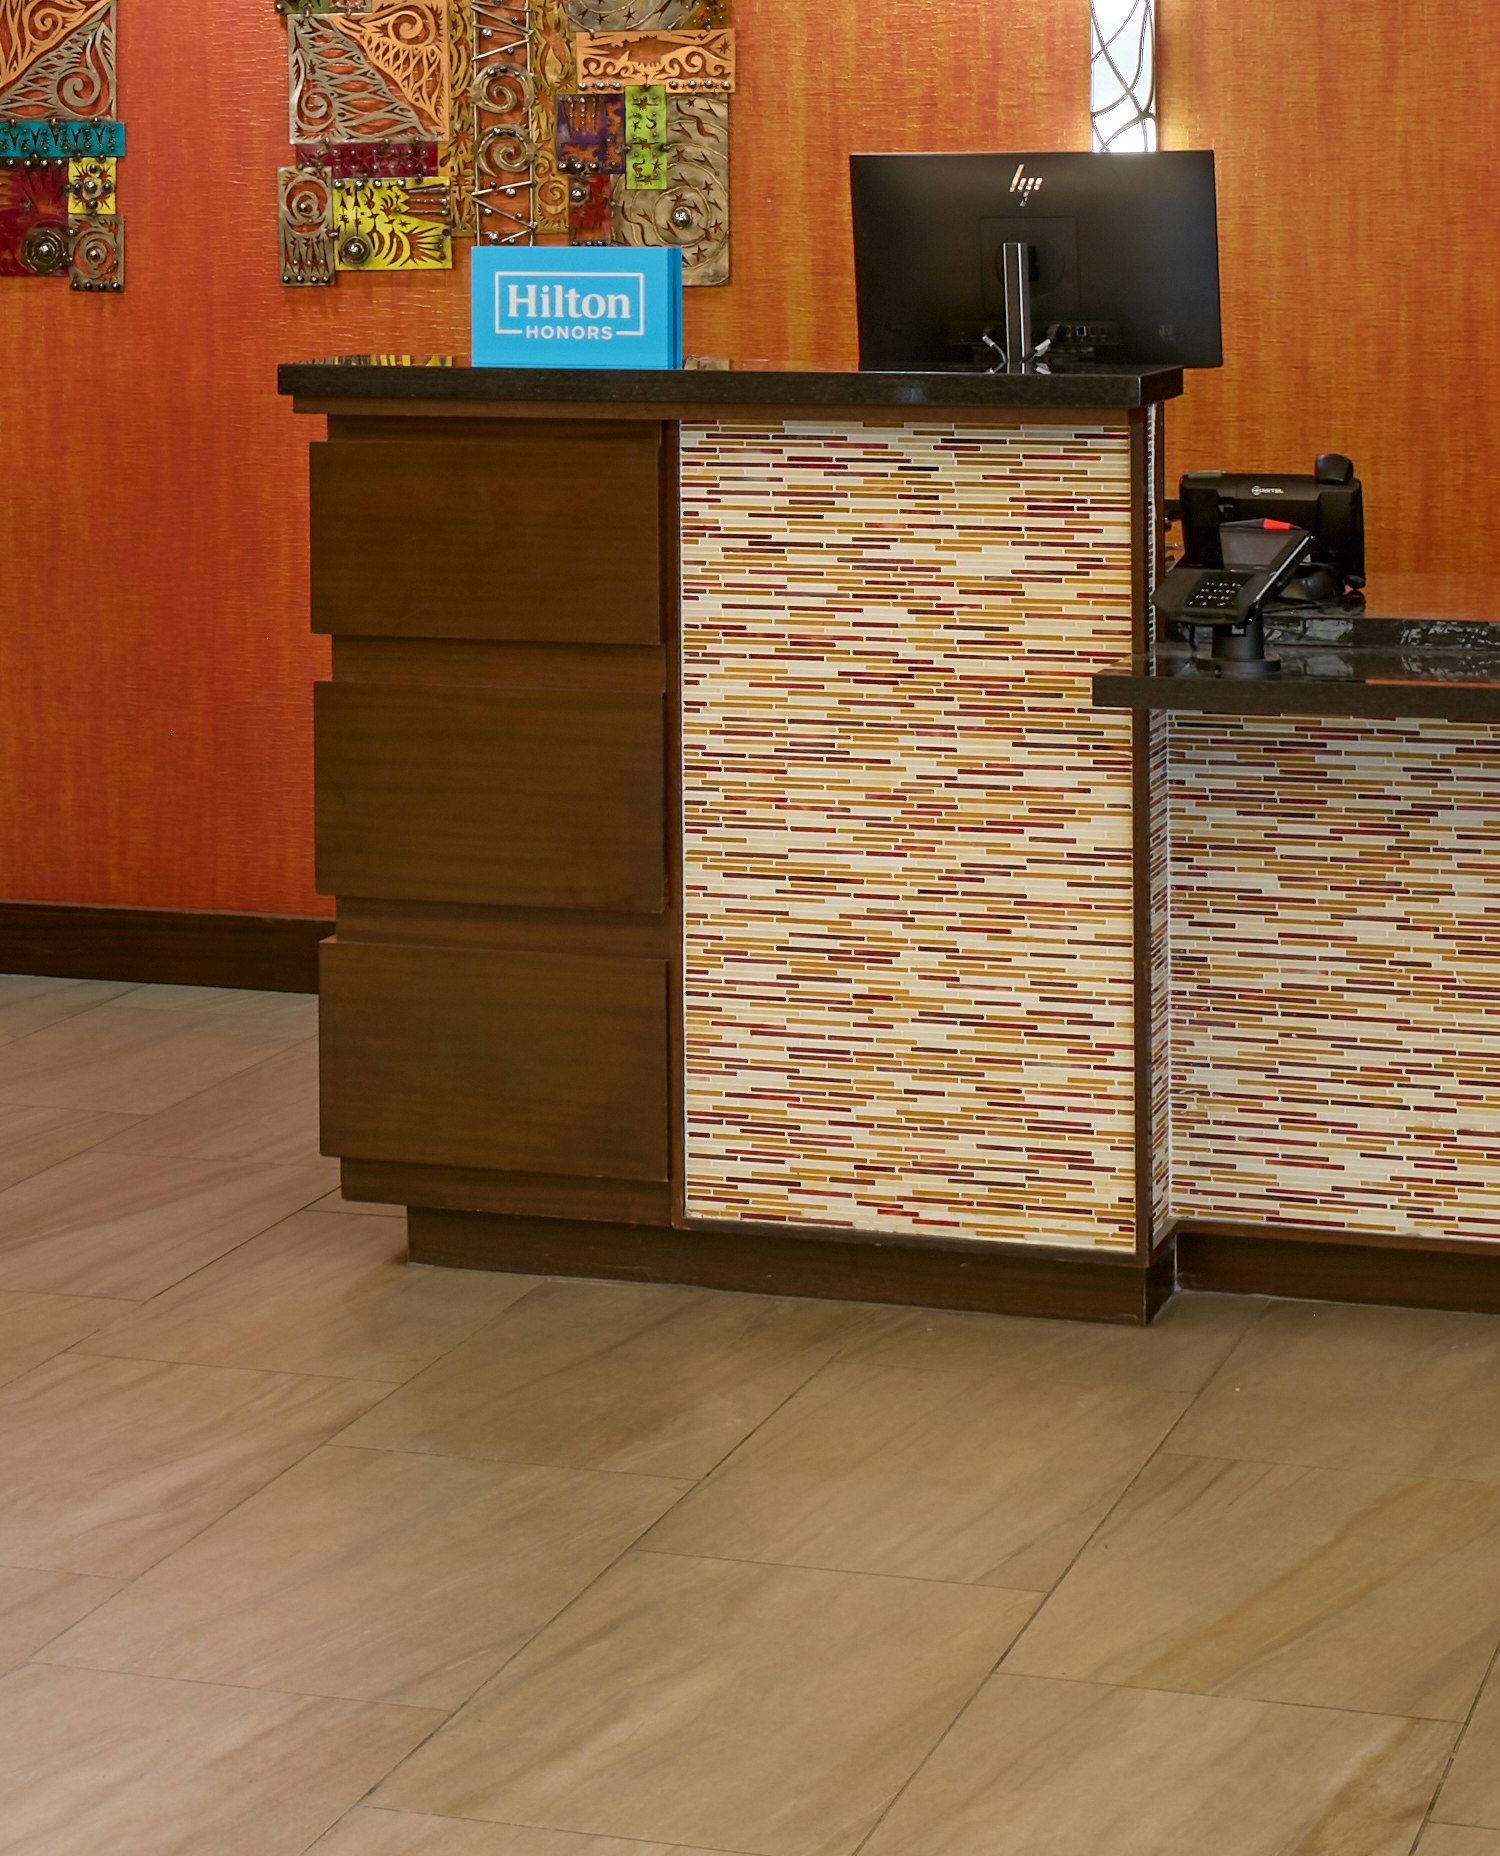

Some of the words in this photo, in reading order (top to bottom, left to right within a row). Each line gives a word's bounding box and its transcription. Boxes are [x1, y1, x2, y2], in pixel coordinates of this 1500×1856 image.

[1009, 163, 1043, 207] hp
[507, 284, 631, 319] Hilton
[526, 325, 613, 341] HONORS
